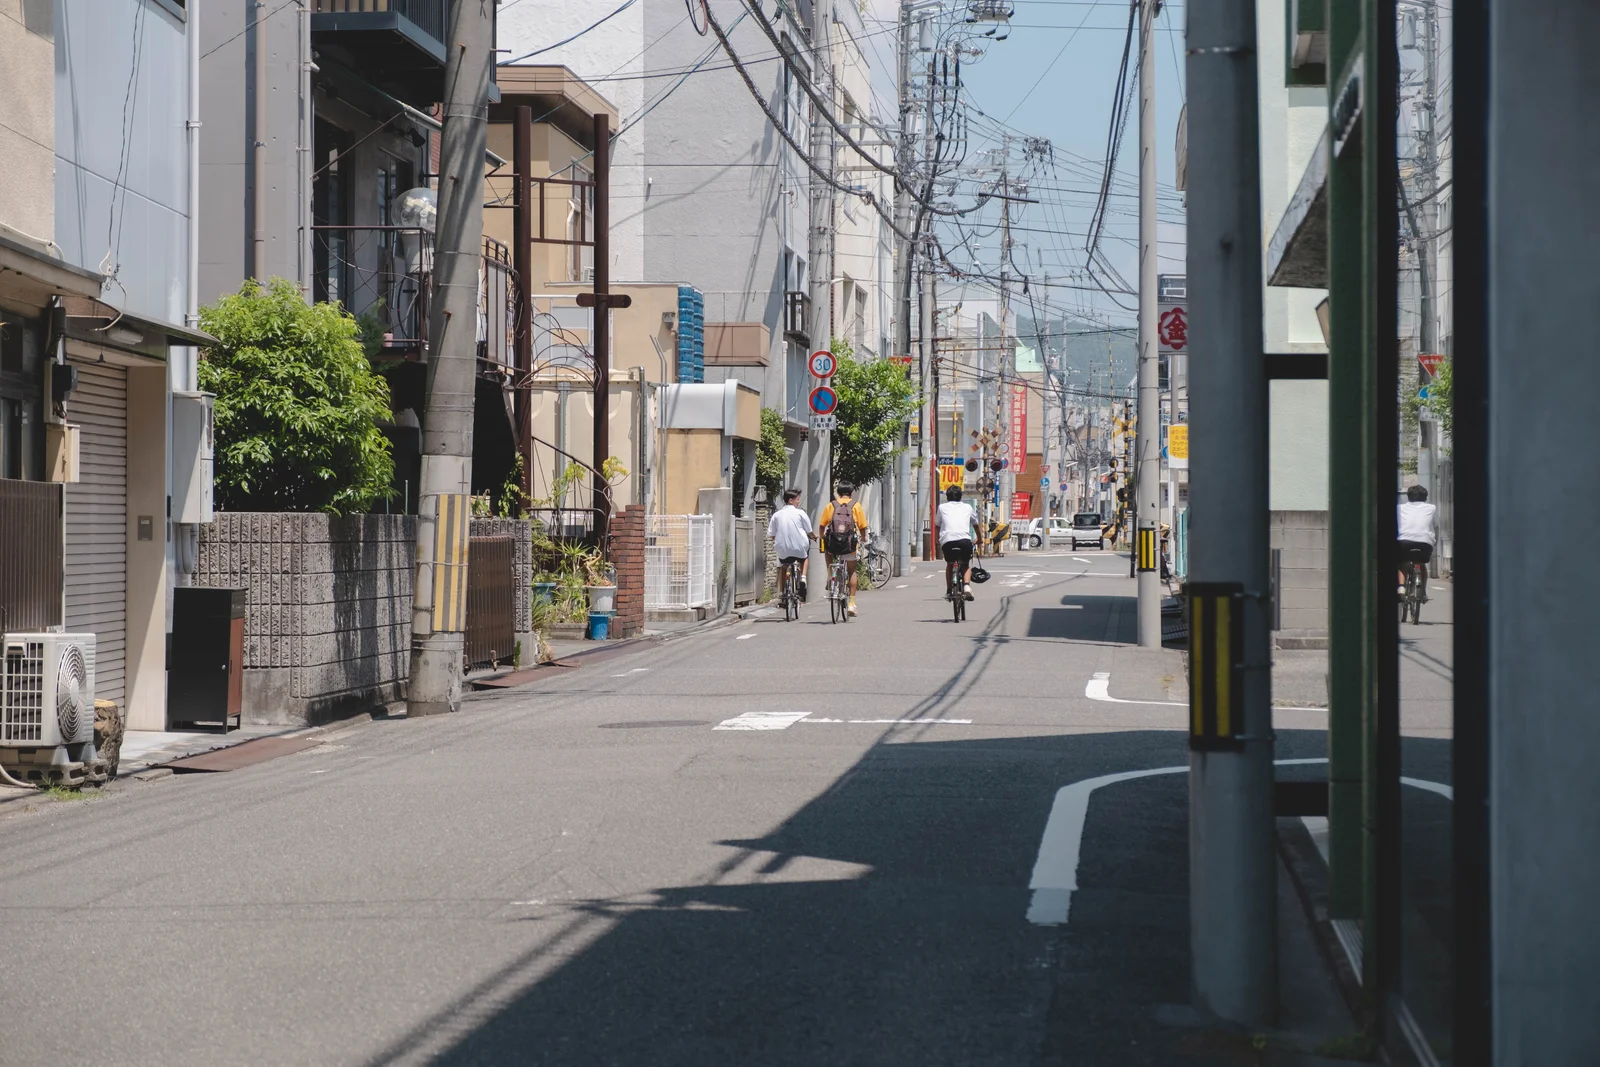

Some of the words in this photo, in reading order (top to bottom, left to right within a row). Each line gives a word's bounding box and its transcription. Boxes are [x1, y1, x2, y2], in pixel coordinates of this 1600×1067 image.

[1164, 314, 1188, 340] 金
[815, 358, 831, 370] 30
[941, 466, 959, 482] 700
